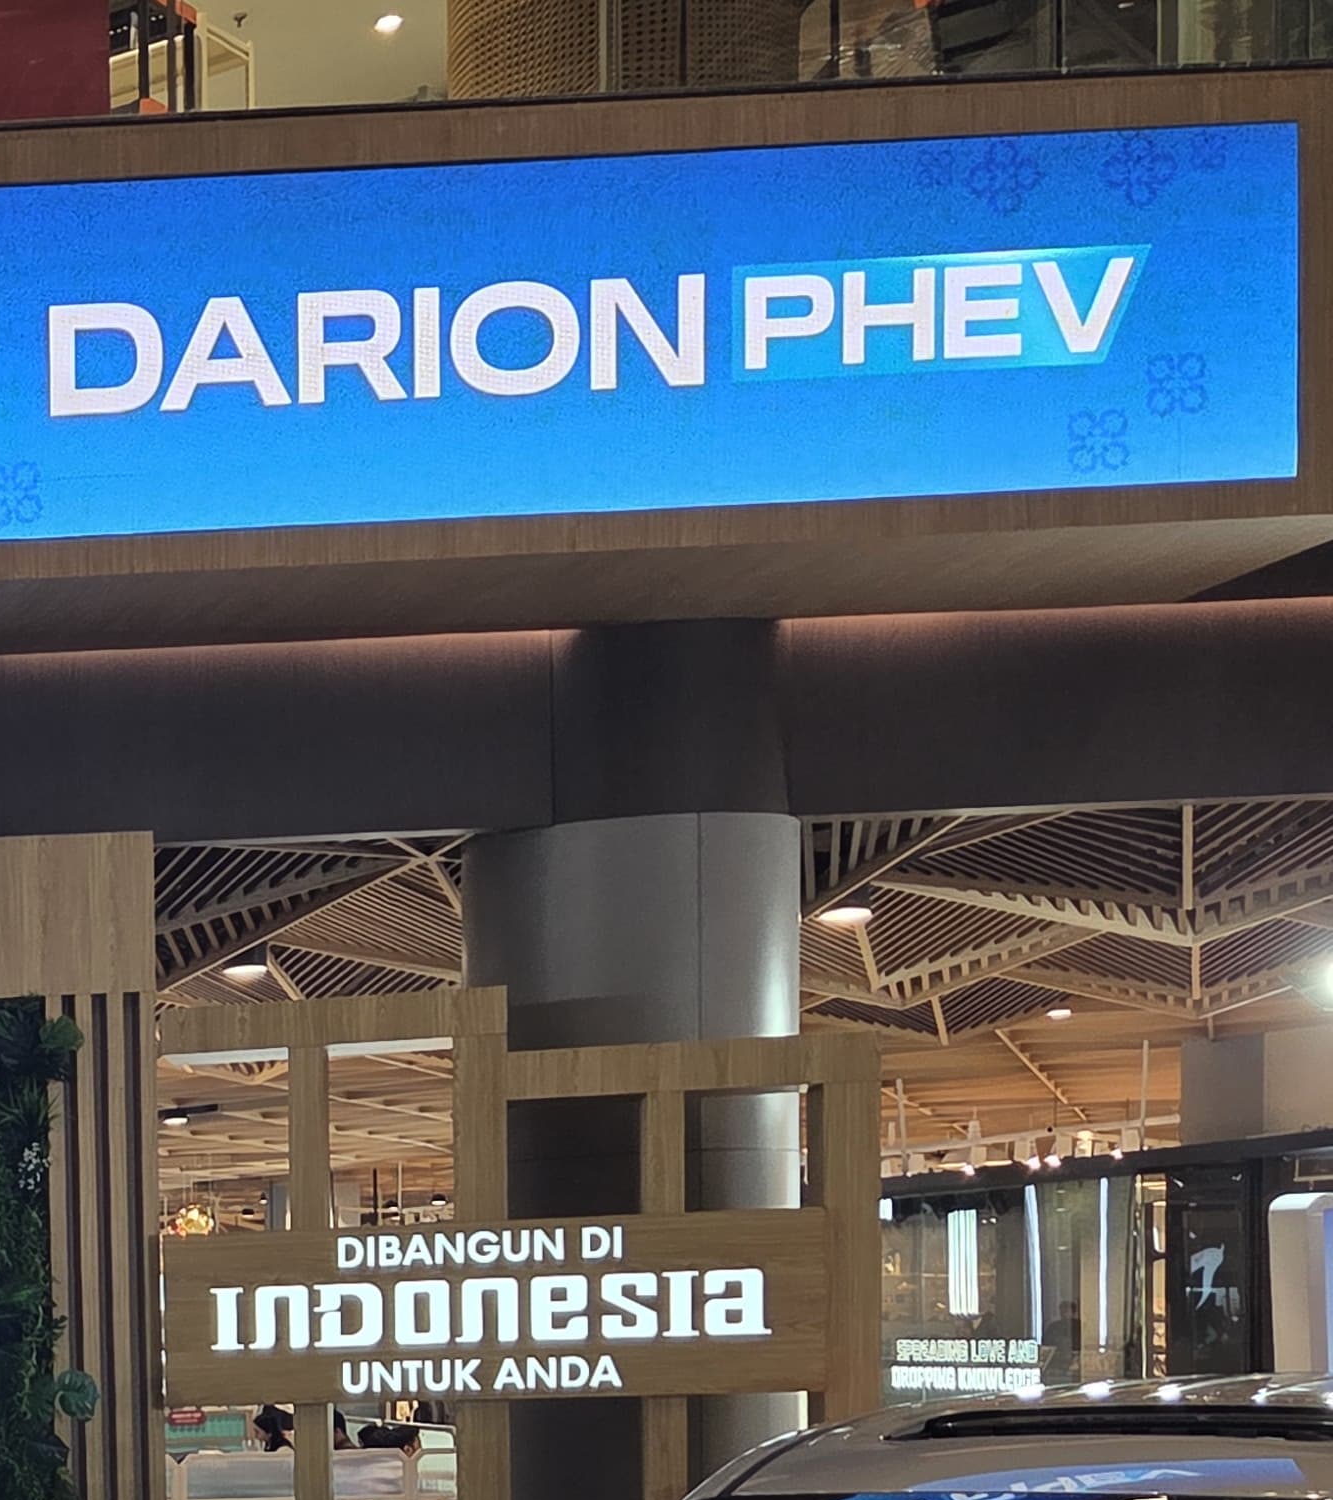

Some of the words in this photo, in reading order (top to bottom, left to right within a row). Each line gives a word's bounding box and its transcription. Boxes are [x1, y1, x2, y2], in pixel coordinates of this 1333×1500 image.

[48, 273, 705, 418] DARION
[744, 257, 1135, 370] PHEV
[336, 1227, 565, 1269] DIBANGUN
[581, 1225, 623, 1260] DI
[970, 1340, 1007, 1364] LOVE
[1007, 1339, 1039, 1364] AND
[341, 1357, 482, 1395] UNTUK
[493, 1354, 623, 1392] ANDA
[891, 1365, 956, 1391] DROPPING
[957, 1366, 1042, 1393] KNOWLEDGE
